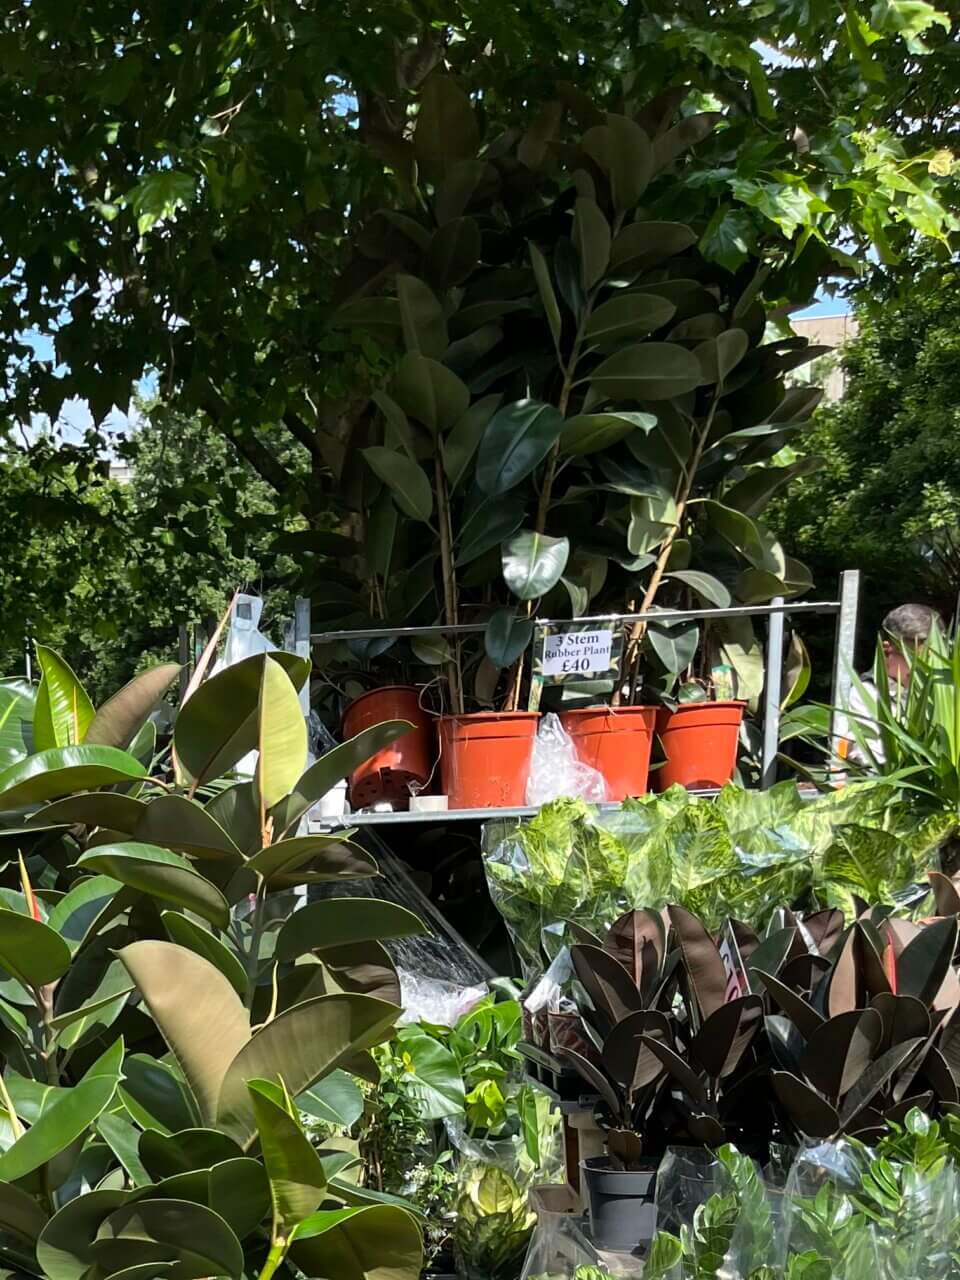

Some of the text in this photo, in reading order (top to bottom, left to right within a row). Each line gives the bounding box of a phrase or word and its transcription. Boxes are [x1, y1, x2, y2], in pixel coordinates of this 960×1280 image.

[555, 634, 599, 647] 3 Stem
[544, 646, 609, 660] Rubber Plant
[561, 658, 590, 672] £40
